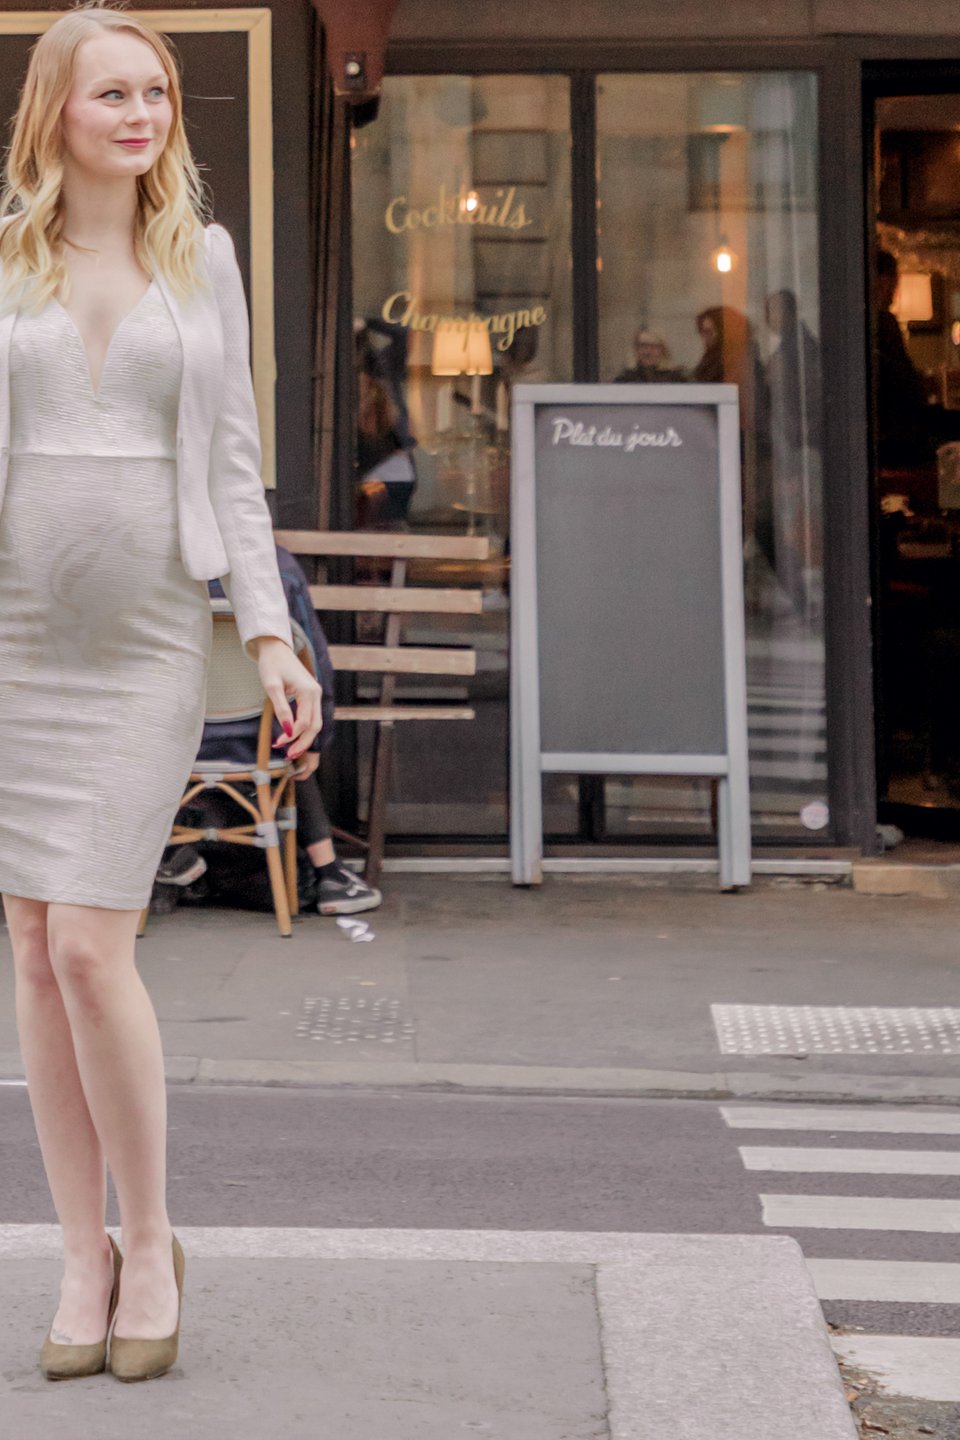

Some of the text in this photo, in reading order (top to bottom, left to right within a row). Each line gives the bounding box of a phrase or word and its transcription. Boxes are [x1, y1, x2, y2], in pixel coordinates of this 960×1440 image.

[382, 291, 547, 352] Champagne
[551, 417, 683, 453] Plat du jour
